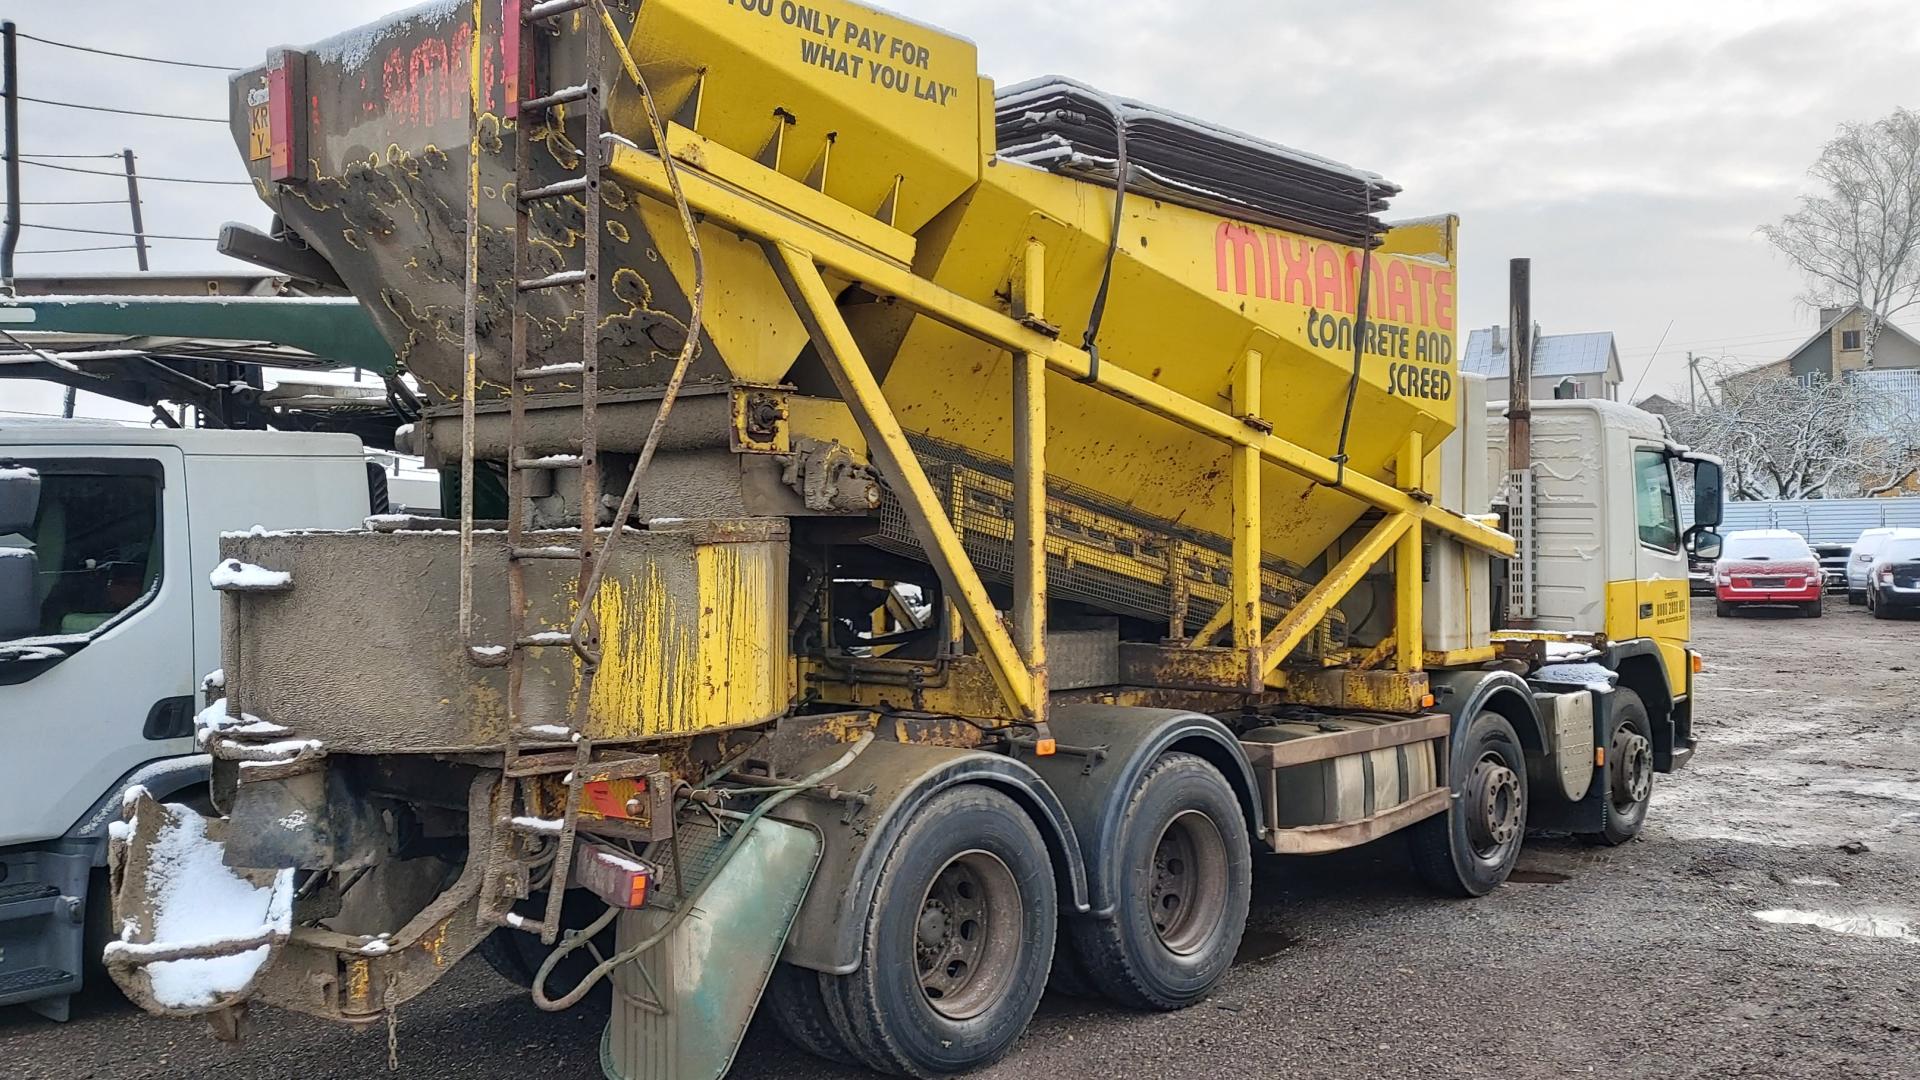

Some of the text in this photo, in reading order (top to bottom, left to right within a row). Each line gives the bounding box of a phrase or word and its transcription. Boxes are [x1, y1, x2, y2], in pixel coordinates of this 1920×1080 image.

[780, 0, 840, 38] ONLY
[844, 21, 886, 54] PAY
[889, 36, 930, 70] FOR
[801, 38, 957, 107] WHAT YOU LAY"
[1215, 220, 1454, 330] MIXAMATE
[1388, 361, 1451, 400] SCREED
[1415, 329, 1452, 365] AND
